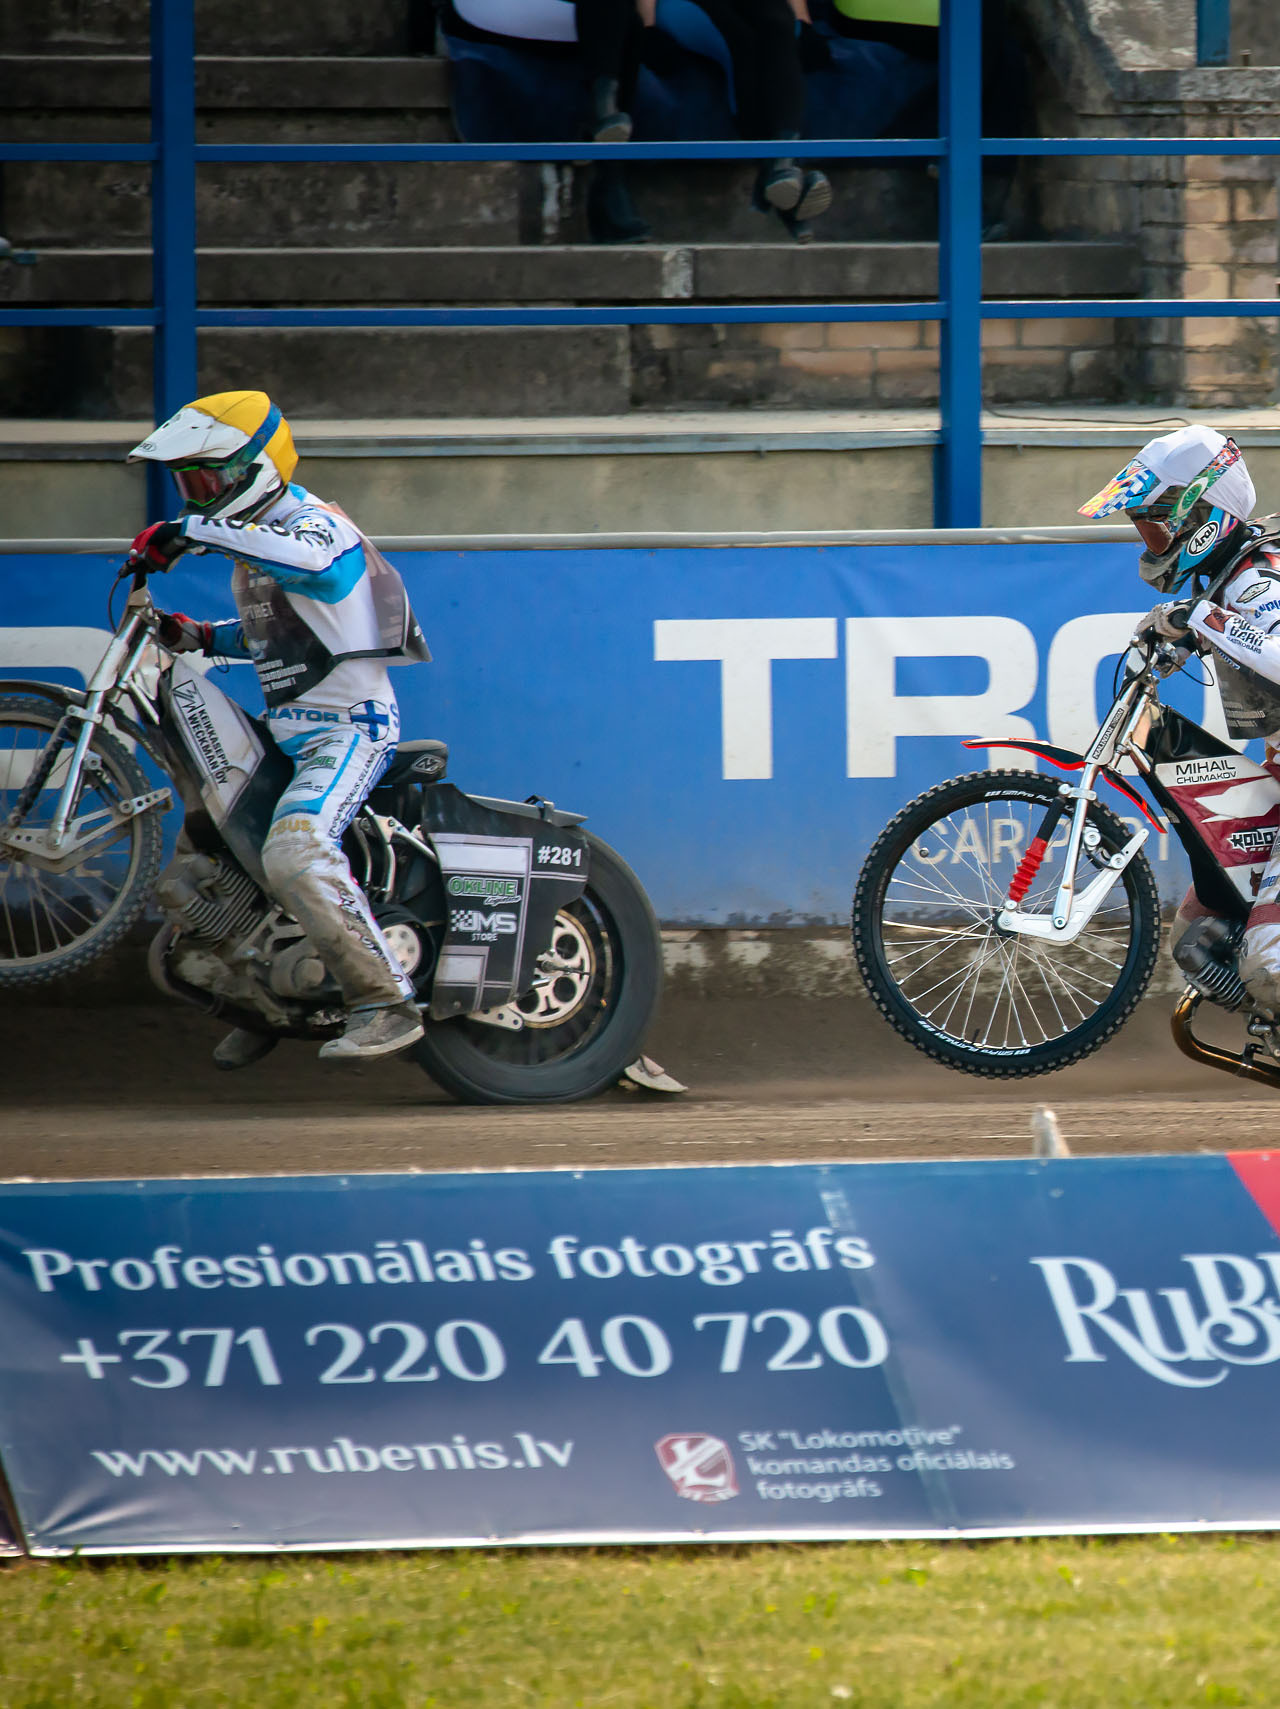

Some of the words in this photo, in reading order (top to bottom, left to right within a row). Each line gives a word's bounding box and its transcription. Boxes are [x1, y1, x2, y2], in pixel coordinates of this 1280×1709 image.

[188, 713, 219, 771] WECKMAN
[1176, 760, 1236, 776] MIHAIL
[1176, 771, 1237, 785] CHUMAKOV
[537, 845, 582, 867] #281
[449, 876, 518, 897] OKLINE
[472, 933, 498, 942] STORE
[23, 1240, 535, 1293] Profesionālais
[549, 1226, 875, 1287] fotogrāfs
[60, 1327, 283, 1389] +371
[306, 1318, 506, 1385] 220
[538, 1313, 672, 1379] 40
[694, 1305, 889, 1373] 720
[738, 1430, 777, 1452] SK
[93, 1432, 574, 1479] www.rubenis.lv
[747, 1453, 892, 1476] komandas
[896, 1449, 1015, 1472] oficiālais
[756, 1477, 883, 1503] fotogrāfs
